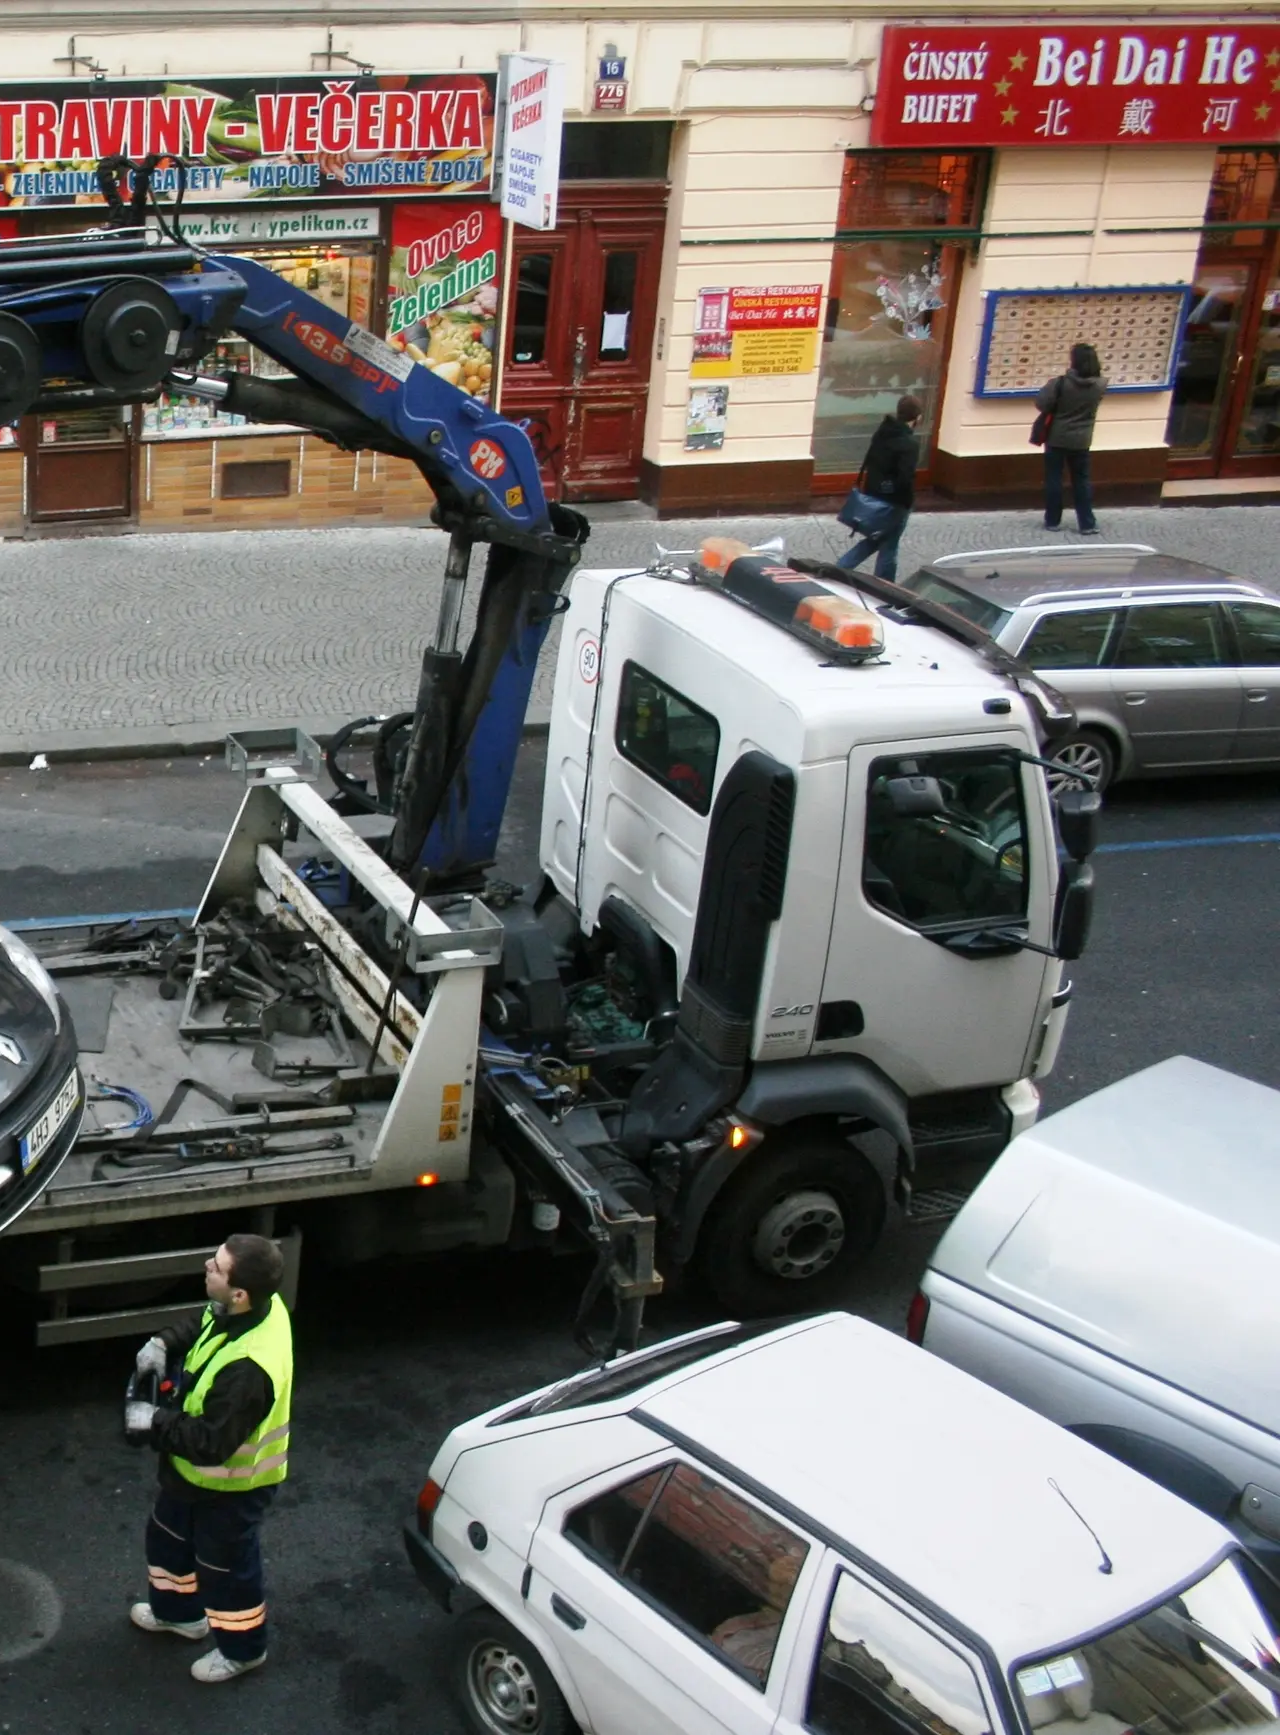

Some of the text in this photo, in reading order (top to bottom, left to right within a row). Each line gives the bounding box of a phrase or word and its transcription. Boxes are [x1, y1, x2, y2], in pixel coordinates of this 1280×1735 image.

[606, 62, 619, 75] 16
[902, 41, 988, 81] ČÍNSKÝ
[1034, 36, 1256, 87] Bei Dai He
[599, 85, 624, 98] 776
[256, 80, 484, 154] VEČERKA
[512, 100, 542, 132] VEČERKA
[901, 94, 978, 124] BUFET
[12, 172, 102, 196] ZELENINA
[128, 167, 225, 193] CGAETY
[249, 161, 320, 190] NÁPOJE
[343, 157, 426, 186] SMÍŠENÉ
[430, 154, 484, 183] ZBOŽÍ
[407, 211, 482, 279] Ovoce
[390, 250, 496, 336] zelenina
[732, 285, 819, 297] CHINESE RESTAURANT
[764, 296, 816, 307] RESTAURACE
[470, 441, 504, 478] PM
[583, 648, 595, 669] 90
[771, 1004, 814, 1018] 240
[30, 1116, 49, 1152] 4H3
